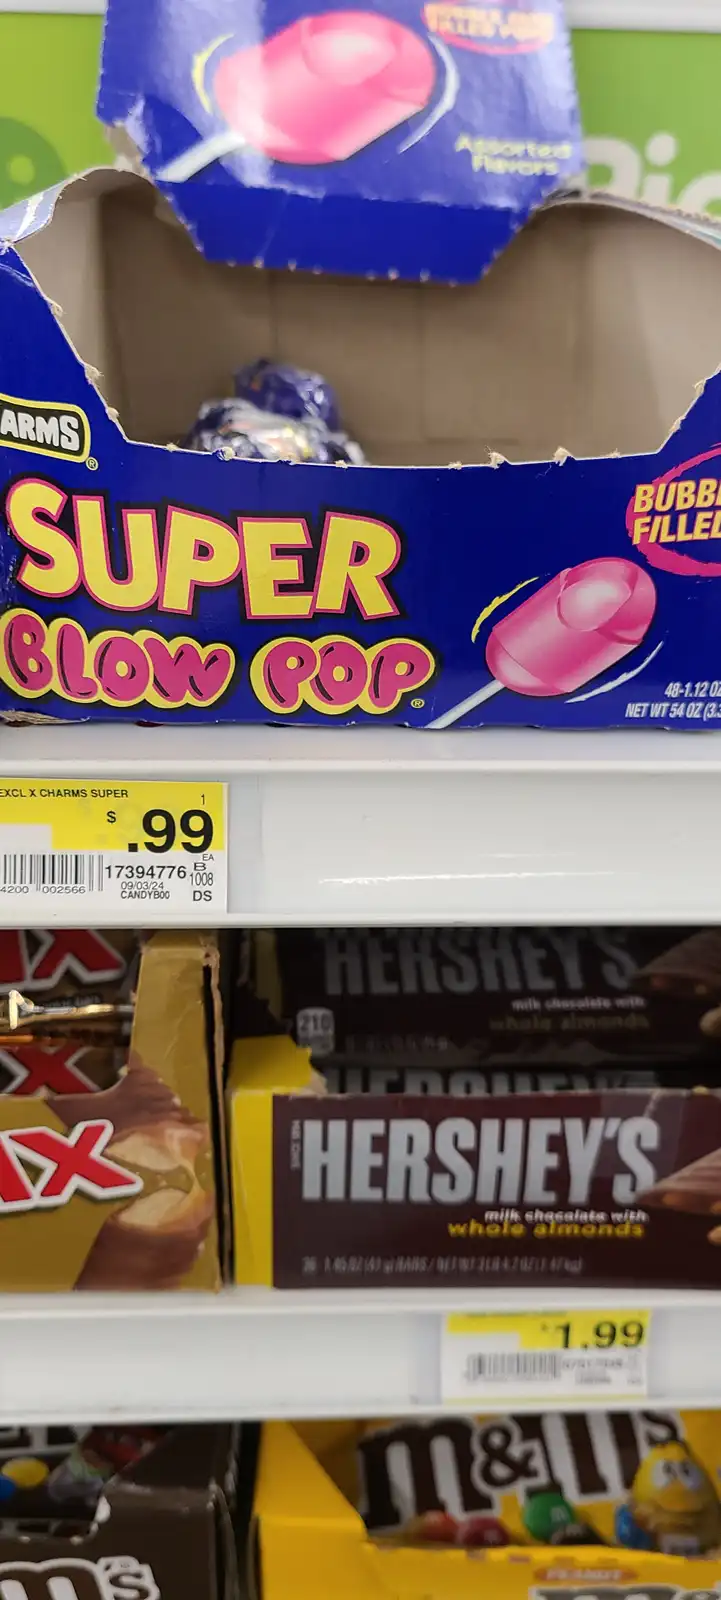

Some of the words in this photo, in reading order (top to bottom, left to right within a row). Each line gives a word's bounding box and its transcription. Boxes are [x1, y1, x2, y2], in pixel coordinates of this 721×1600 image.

[634, 478, 721, 512] BUBB
[6, 477, 402, 621] SUPER
[1, 609, 235, 707] BLOW
[251, 636, 435, 714] POP
[664, 681, 708, 698] 48-1.12
[625, 702, 649, 718] NET
[650, 702, 669, 718] WT
[669, 702, 686, 718] 54
[686, 702, 704, 718] OZ
[0, 788, 27, 798] EXCL
[29, 789, 37, 797] X
[40, 789, 88, 798] CHARMS
[91, 789, 128, 798] SUPER
[106, 810, 117, 824] $
[128, 808, 214, 854] .99
[202, 853, 214, 861] EA
[105, 865, 187, 879] 17394776
[193, 862, 207, 872] B
[190, 872, 214, 886] 1008
[42, 885, 87, 894] 002566
[120, 880, 164, 891] 09/03/24
[192, 889, 213, 902] DS
[303, 1116, 660, 1206] HERSHEY'S
[484, 1208, 521, 1223] milk
[524, 1208, 608, 1222] chocolate
[611, 1207, 649, 1222] with
[447, 1219, 527, 1238] whole
[533, 1219, 645, 1239] almonds
[555, 1320, 645, 1350] 1.99
